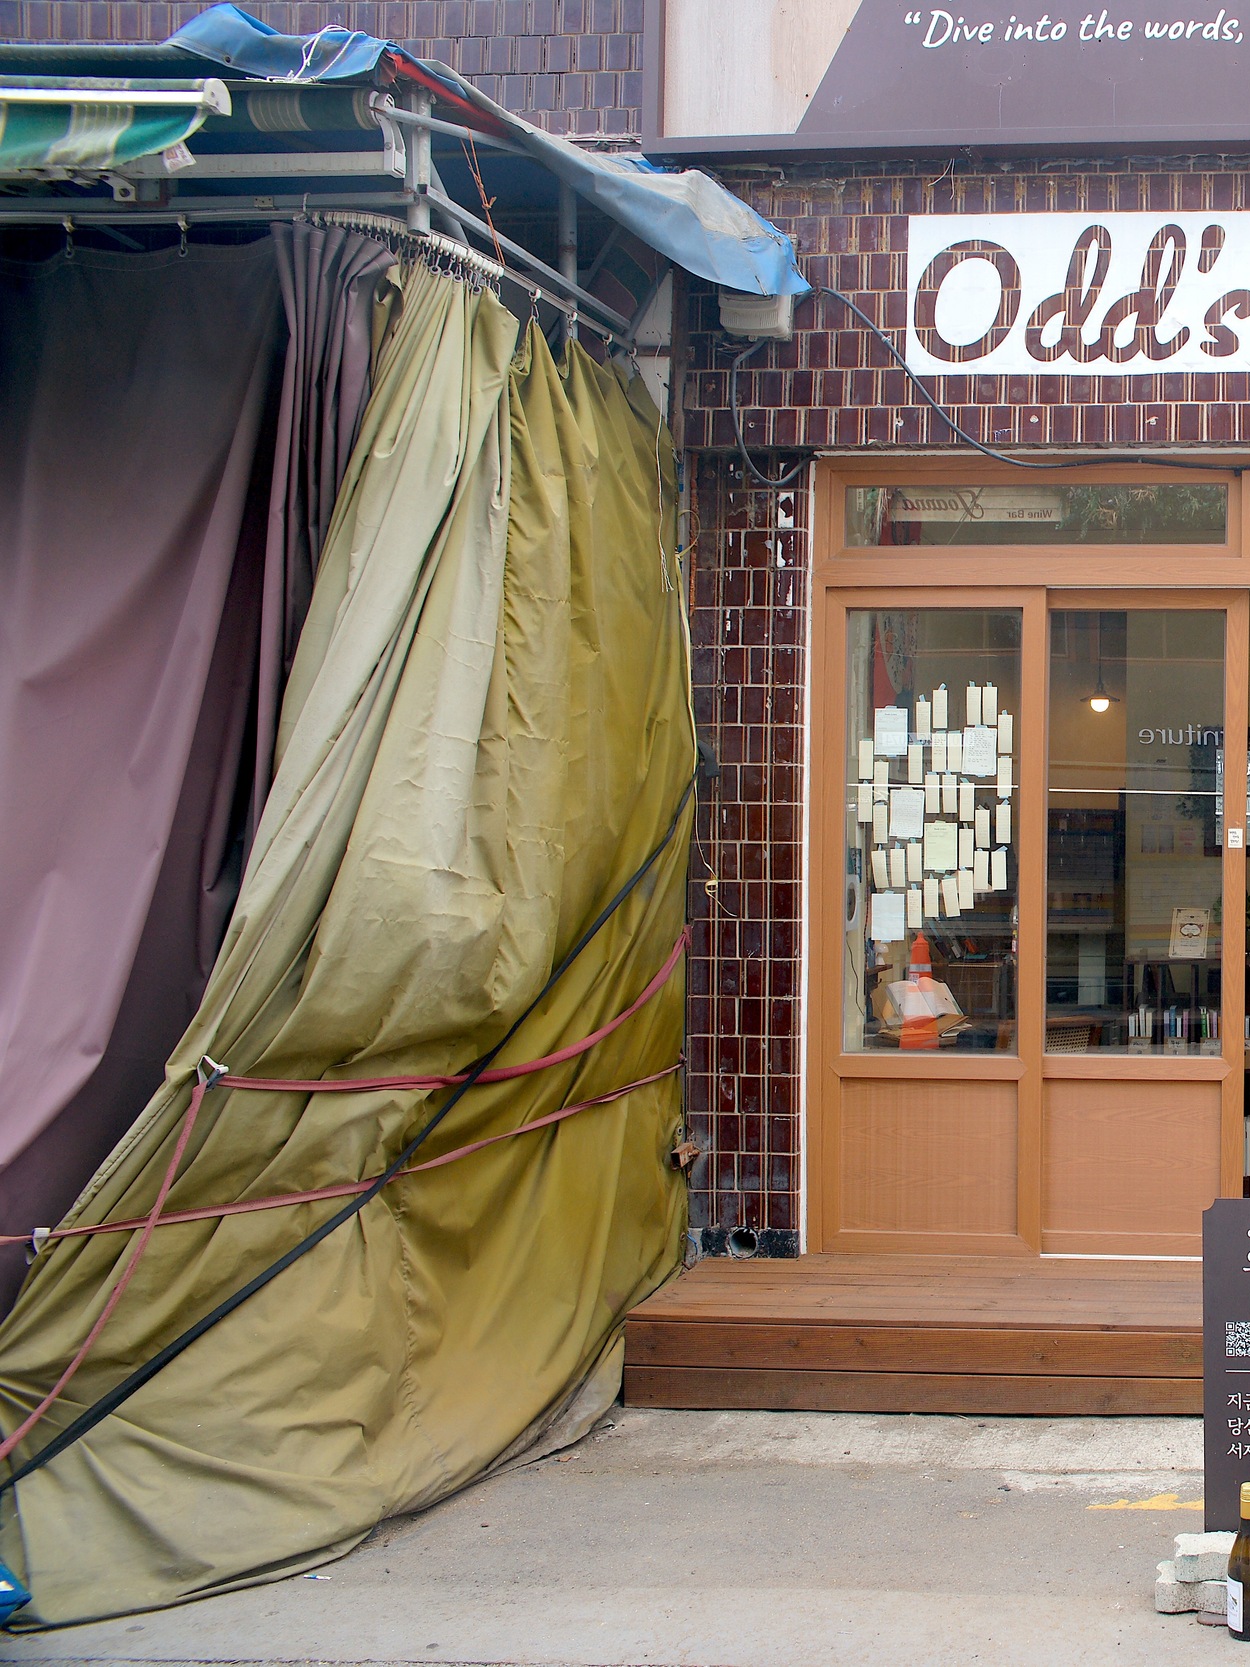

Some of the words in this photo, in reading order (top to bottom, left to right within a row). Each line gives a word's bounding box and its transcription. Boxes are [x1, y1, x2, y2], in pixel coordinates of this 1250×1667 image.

[1004, 14, 1067, 41] into
[1079, 9, 1132, 41] the
[1144, 9, 1244, 44] words,
